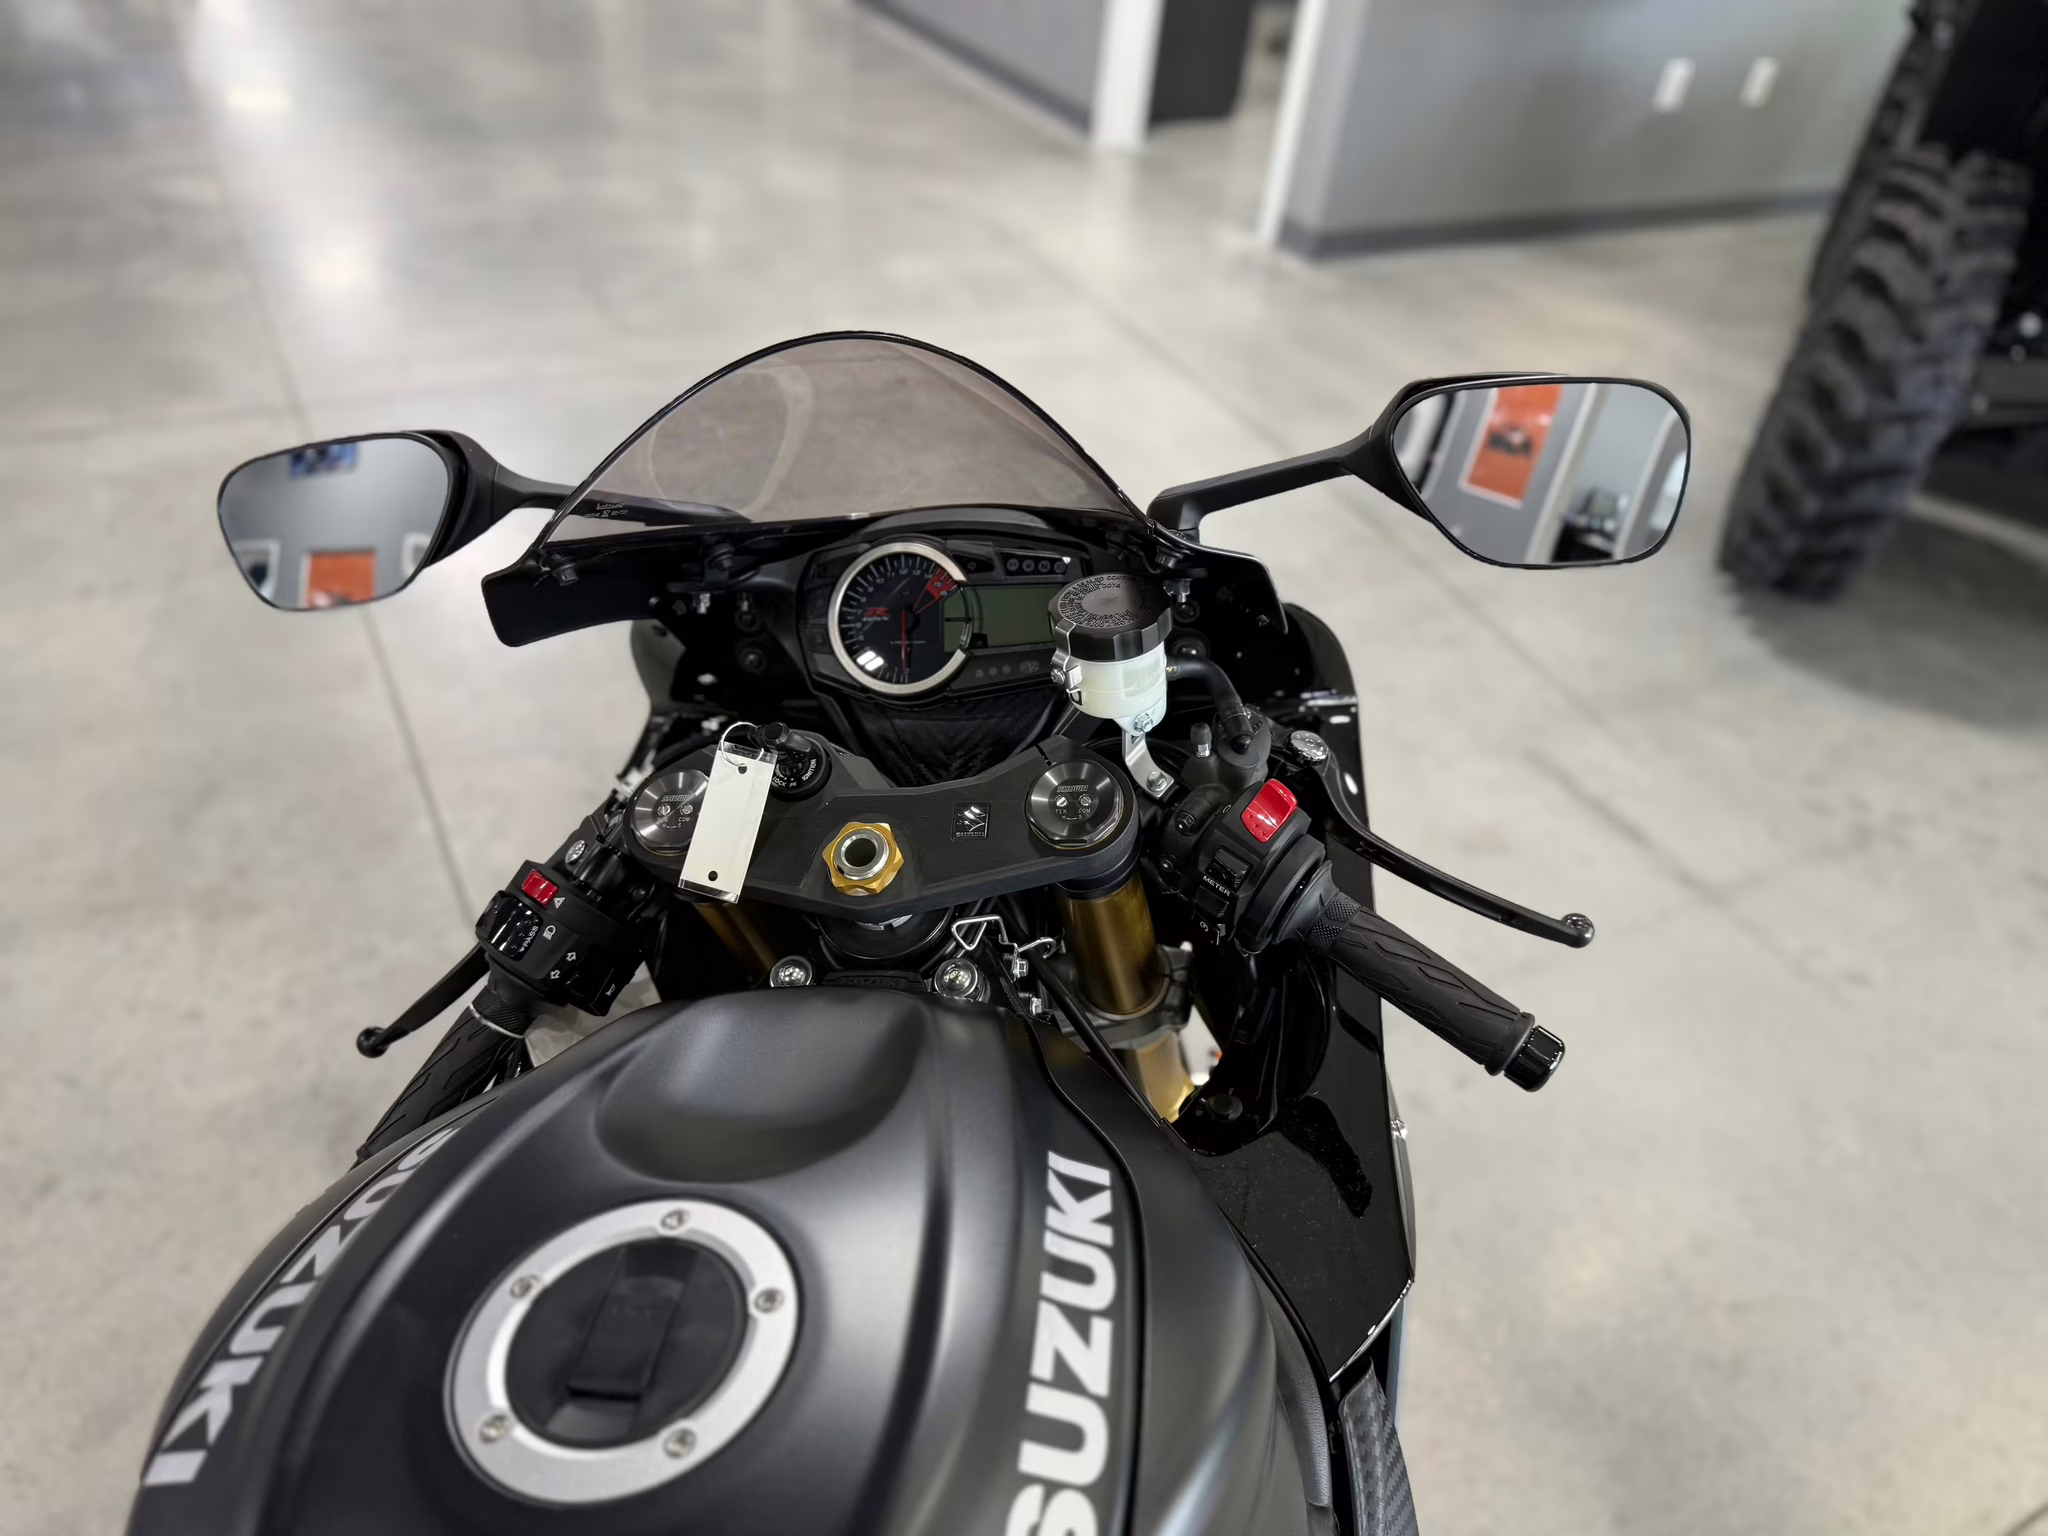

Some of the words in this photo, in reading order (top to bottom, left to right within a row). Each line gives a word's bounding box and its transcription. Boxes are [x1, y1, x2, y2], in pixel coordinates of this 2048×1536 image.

[801, 758, 817, 782] IGNITION
[772, 776, 788, 788] LOCK
[1202, 874, 1231, 897] METER
[522, 925, 539, 948] PASS
[142, 1127, 461, 1486] SUZUKI
